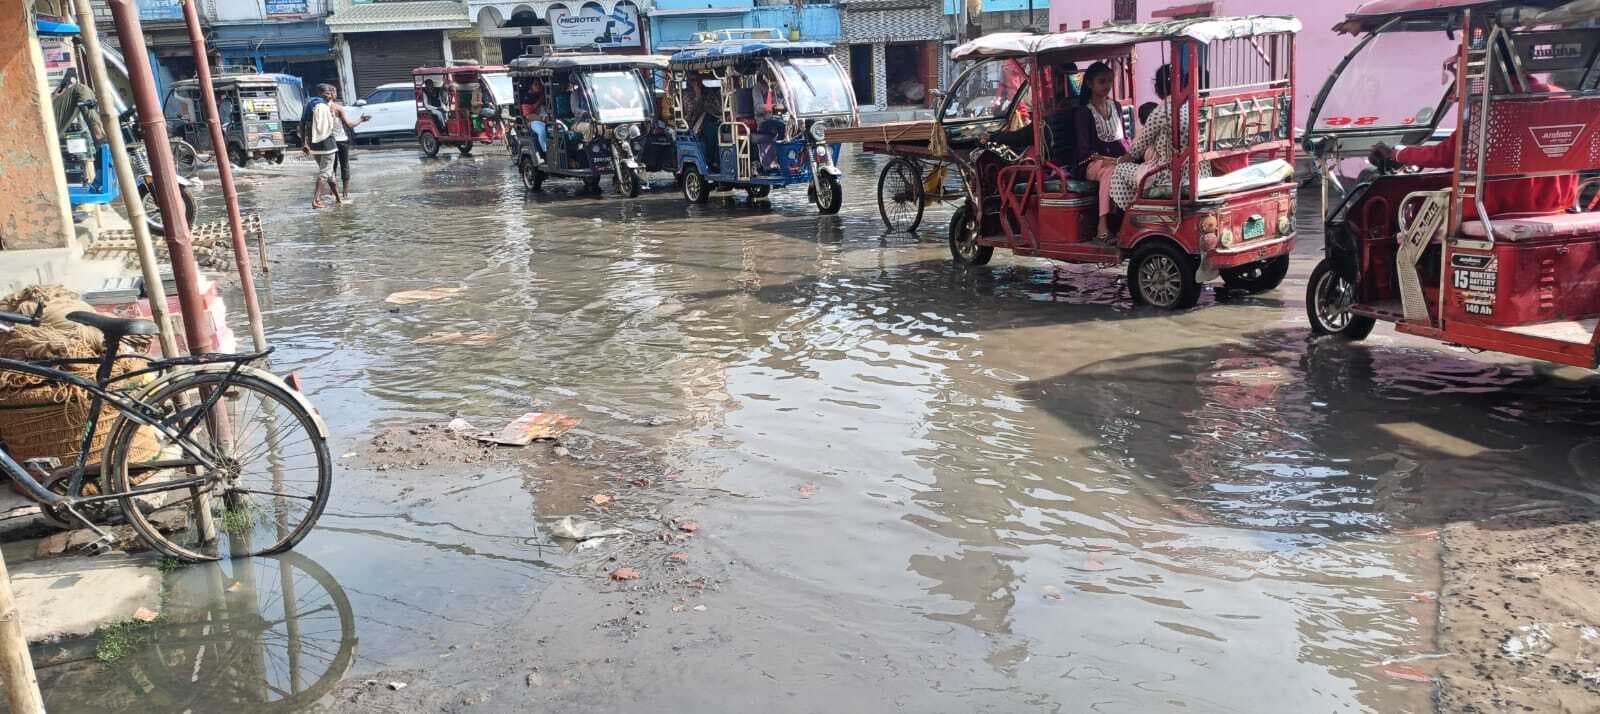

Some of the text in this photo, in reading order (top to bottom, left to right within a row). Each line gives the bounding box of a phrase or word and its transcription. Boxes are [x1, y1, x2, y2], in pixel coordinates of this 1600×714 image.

[560, 16, 601, 24] MICROTEK
[1470, 271, 1496, 279] MONTHS
[1454, 270, 1469, 289] 15
[1469, 278, 1496, 286] BATTERY
[1466, 304, 1492, 315] 140 Ah
